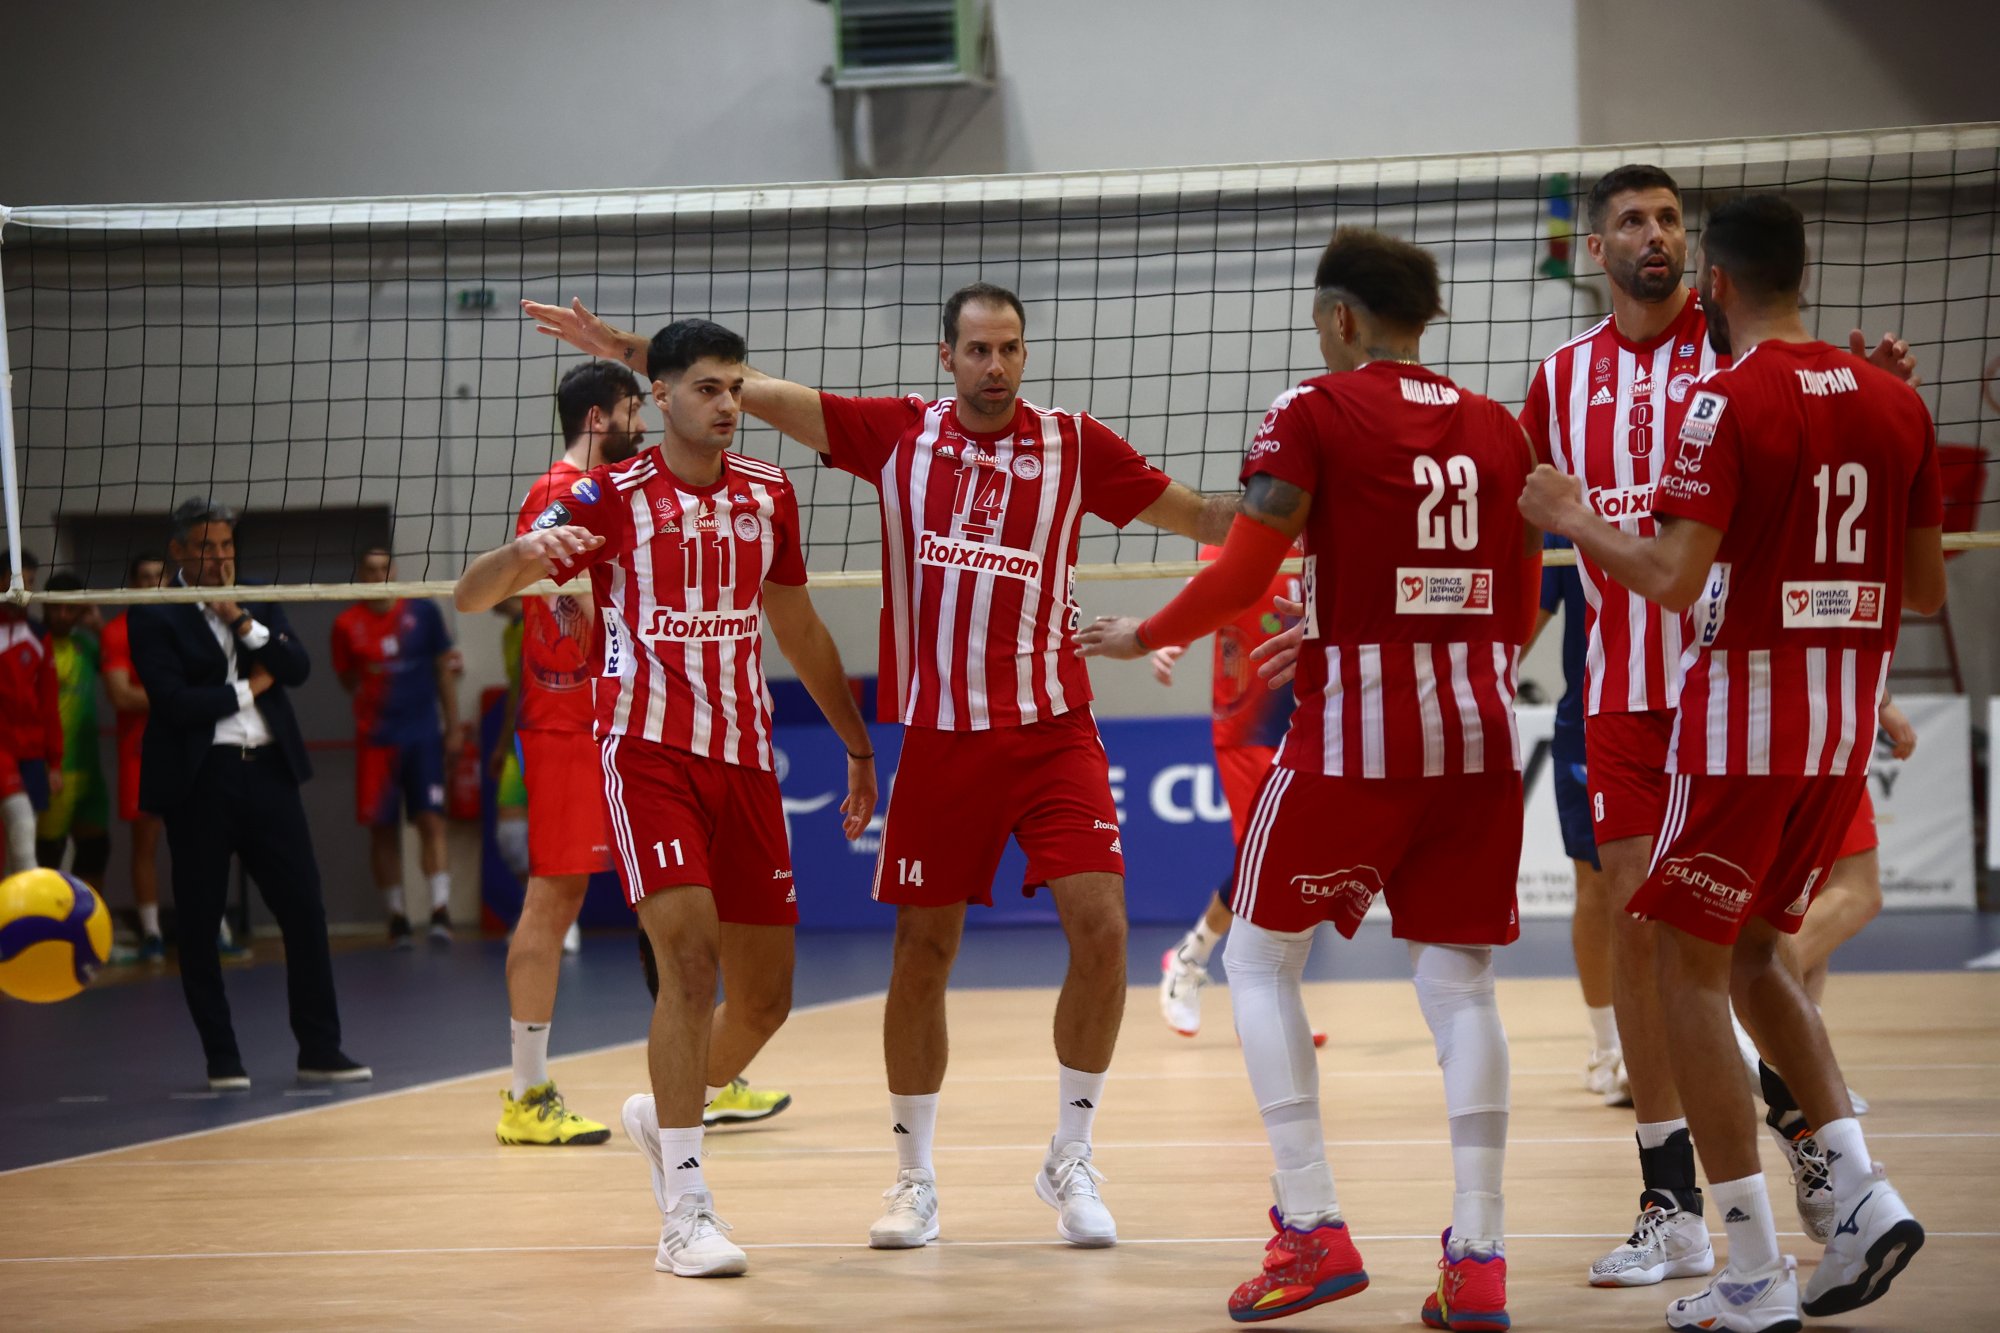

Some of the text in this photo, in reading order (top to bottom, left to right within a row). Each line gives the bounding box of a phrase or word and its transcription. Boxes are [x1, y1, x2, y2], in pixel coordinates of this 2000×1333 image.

[1589, 396, 1615, 406] adidas
[1693, 397, 1717, 420] B
[1628, 402, 1654, 459] 8
[953, 466, 1008, 522] 14
[1412, 454, 1479, 551] 23
[1665, 489, 1692, 500] PAINTS
[553, 504, 566, 515] CEV
[1813, 461, 1868, 564] 12
[679, 536, 731, 589] 11
[919, 534, 1040, 578] Stoiximan
[1475, 577, 1488, 589] 20
[1860, 590, 1876, 602] 20
[652, 838, 685, 869] 11
[897, 857, 924, 887] 14
